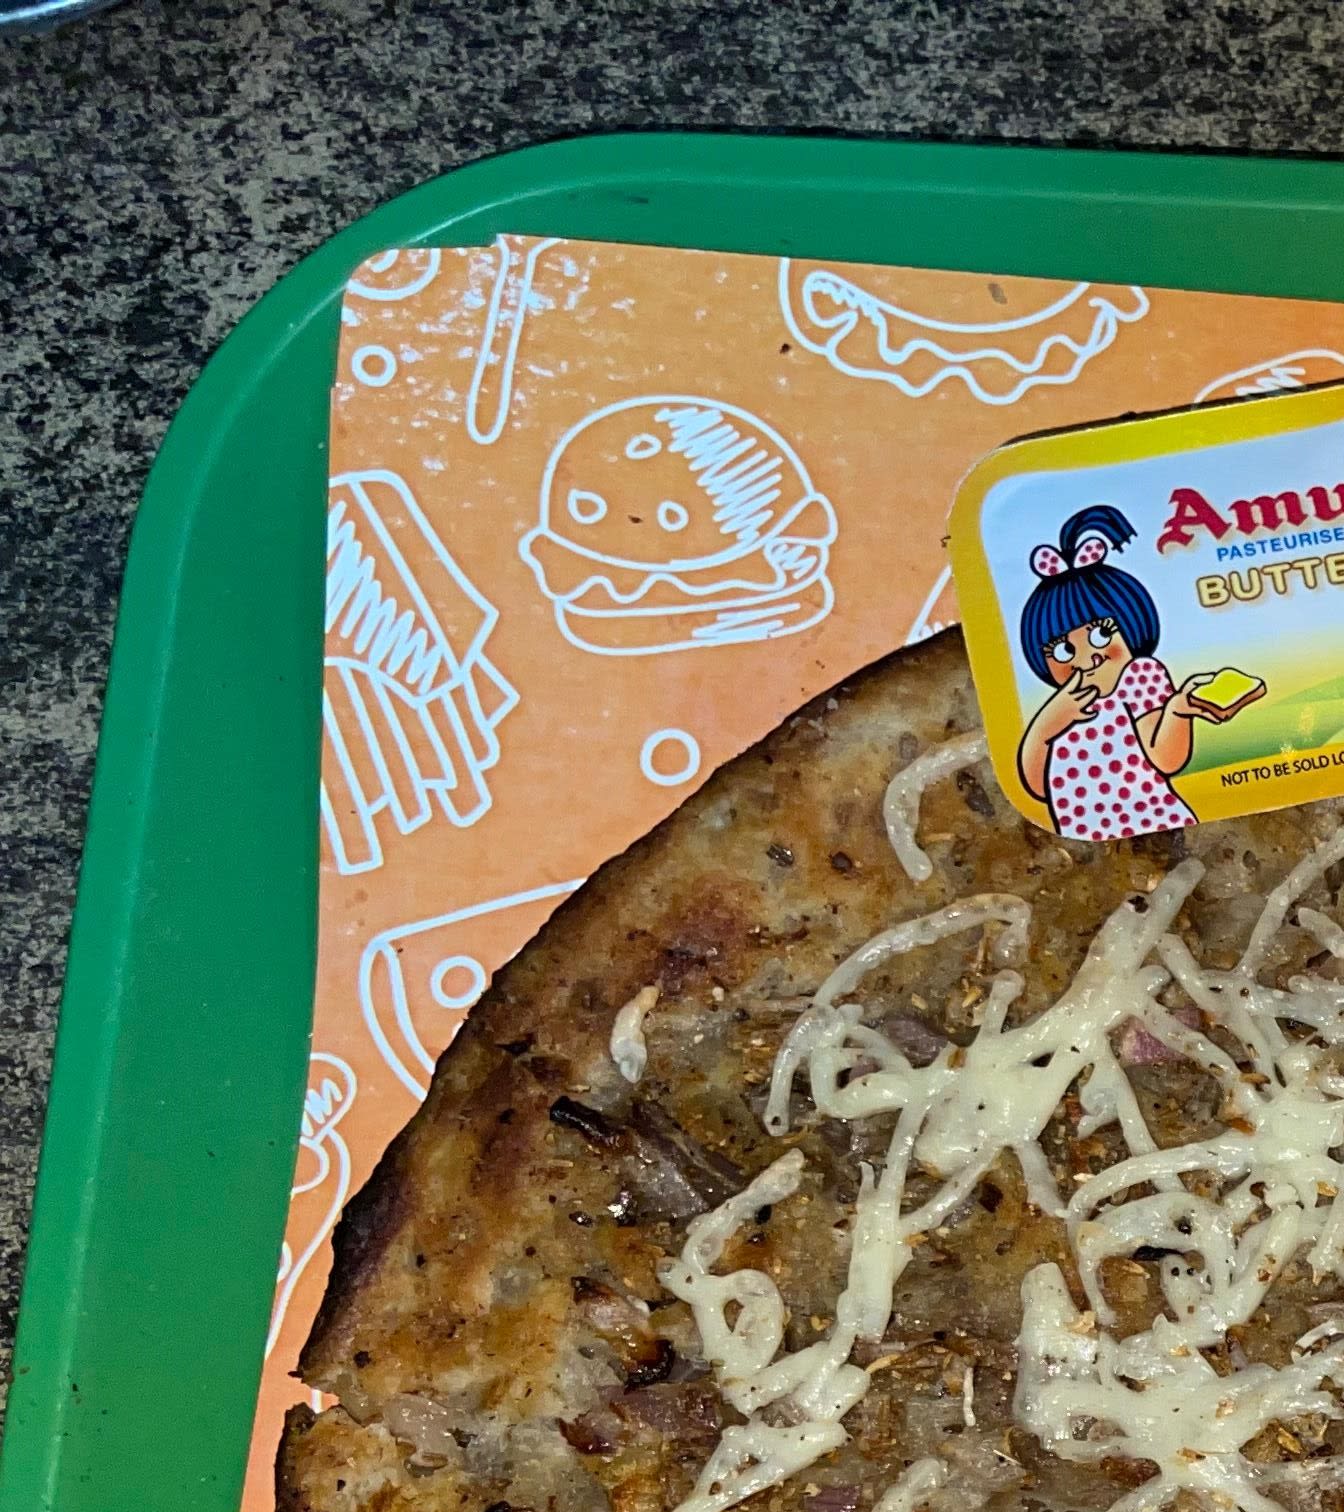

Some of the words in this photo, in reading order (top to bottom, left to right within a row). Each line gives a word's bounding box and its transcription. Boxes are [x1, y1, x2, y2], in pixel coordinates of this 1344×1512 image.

[1220, 769, 1250, 787] NOT
[1251, 766, 1271, 781] TO
[1273, 763, 1291, 777] BE
[1293, 755, 1330, 773] SOLD
